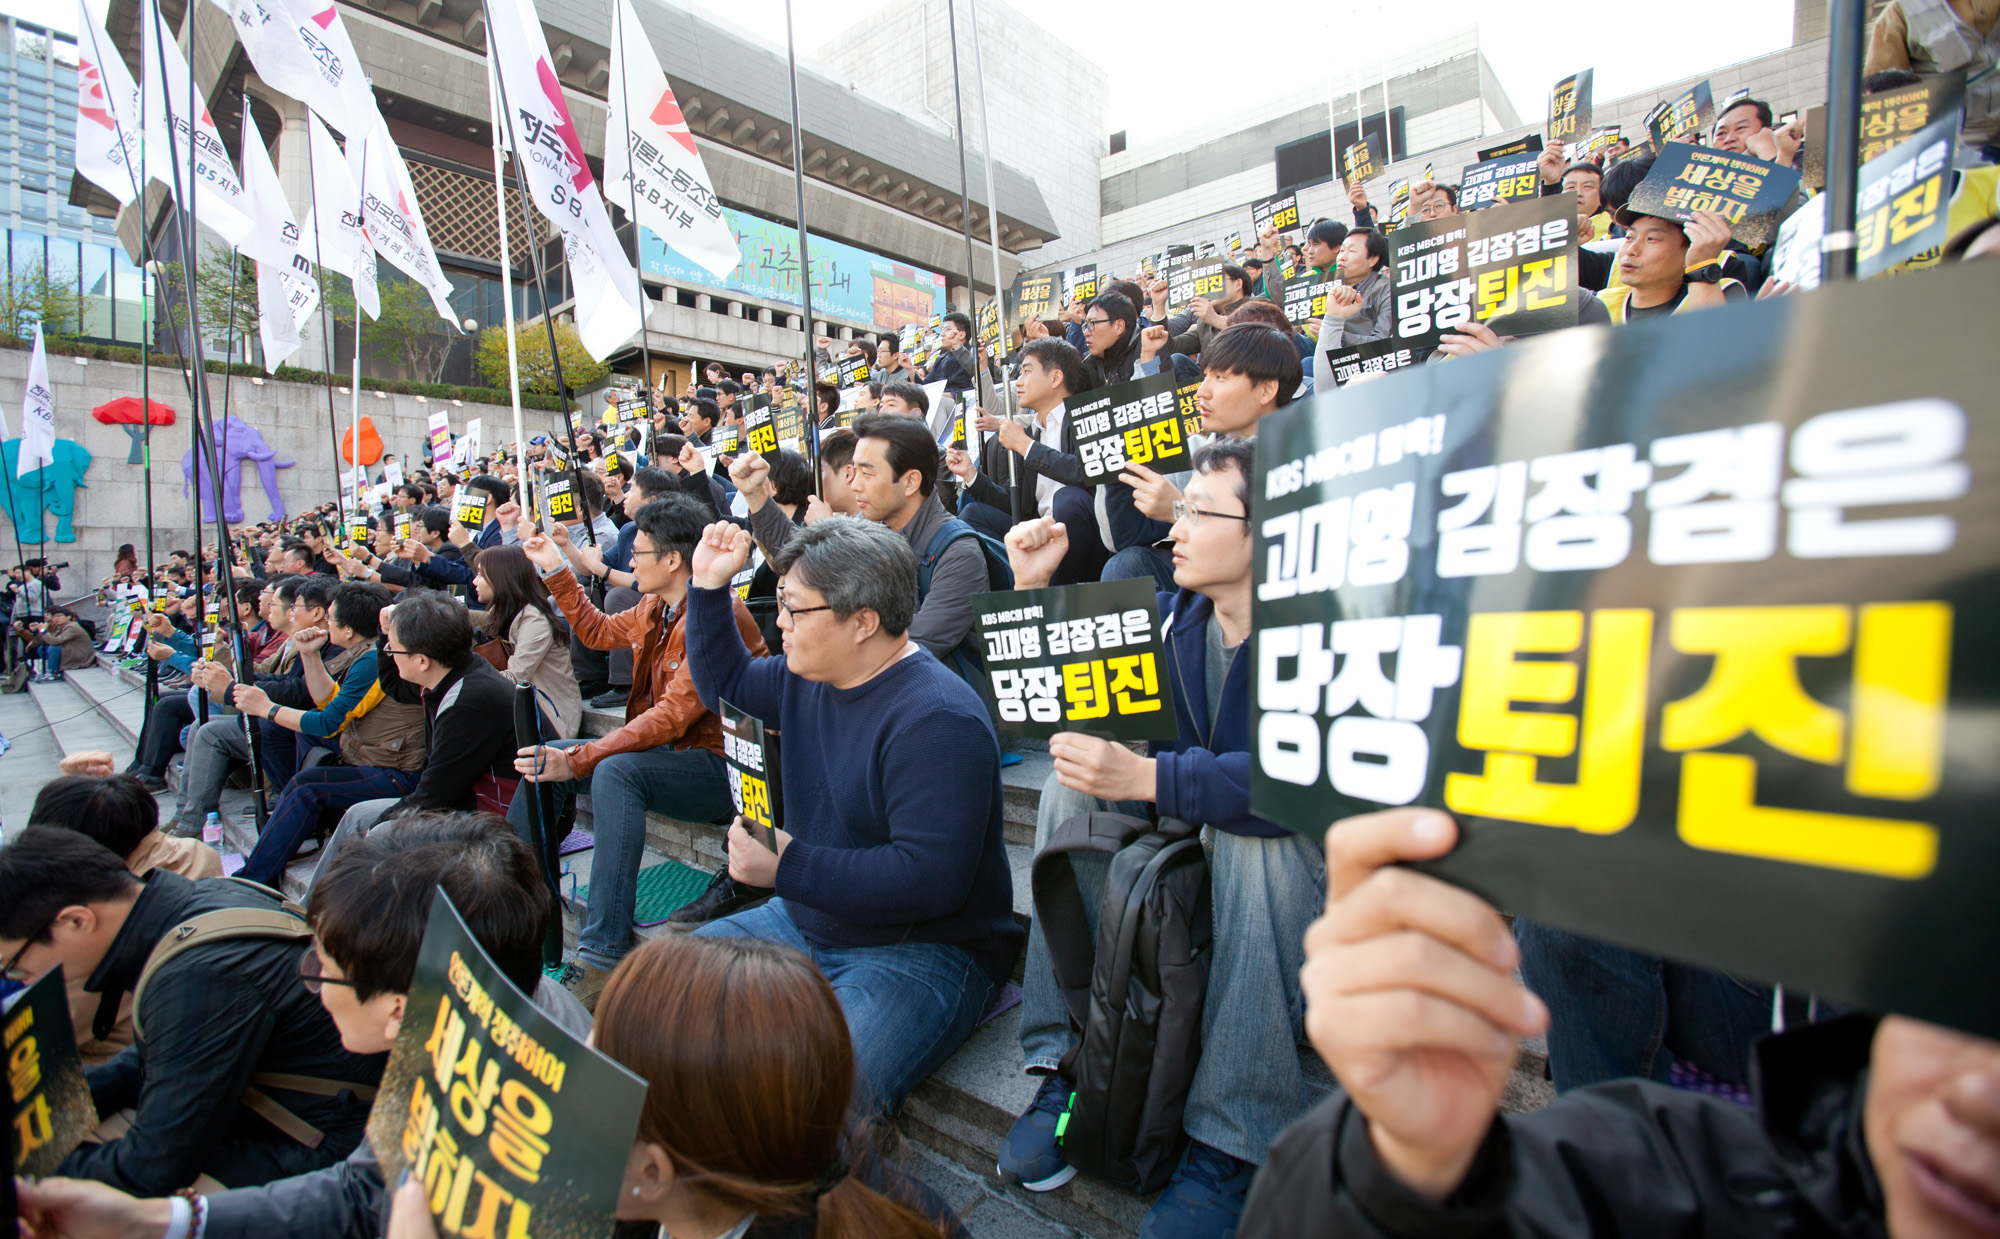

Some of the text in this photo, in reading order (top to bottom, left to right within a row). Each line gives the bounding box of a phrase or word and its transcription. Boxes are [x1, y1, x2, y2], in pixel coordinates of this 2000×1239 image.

[1550, 92, 1577, 118] 상을
[1551, 114, 1576, 139] 히자
[1859, 102, 1930, 140] 상을
[1690, 151, 1731, 167] 언론개혁
[1462, 160, 1539, 189] 고대영 김장겸은
[1674, 162, 1763, 199] 세상을
[551, 184, 591, 228] SB
[1460, 174, 1537, 208] 당장 퇴진
[1663, 185, 1749, 225] 밝히자
[1273, 206, 1298, 229] 퇴진
[1396, 245, 1460, 288] 고대영
[1466, 218, 1569, 269] 김장겸은
[1398, 243, 1416, 257] KBS
[1416, 234, 1445, 252] MBC의
[1190, 262, 1223, 280] 김장겸은
[1019, 284, 1051, 302] 세상을
[1074, 280, 1096, 301] 퇴진
[1168, 274, 1224, 306] 당장 퇴진
[1284, 287, 1308, 303] 고대영
[1397, 255, 1569, 339] 당장 퇴진
[1019, 300, 1049, 319] 밝히자
[1284, 295, 1327, 322] 당장 퇴
[853, 365, 870, 381] 퇴진
[1361, 348, 1413, 374] 김장겸은
[776, 414, 796, 430] 세상을
[1072, 390, 1176, 441] 고대영 김장겸은
[722, 438, 738, 453] 퇴진
[748, 423, 777, 455] 퇴진
[1078, 416, 1184, 478] 당장 퇴진
[551, 492, 574, 516] 퇴진
[1257, 397, 1971, 601] 고대영 김장겸은
[457, 505, 484, 524] 퇴진
[981, 613, 998, 626] KBS
[998, 608, 1024, 624] MBC의
[983, 608, 1152, 662] 고대영 김장겸은
[990, 652, 1162, 722] 당장 퇴진
[1257, 600, 1953, 881] 당장 퇴진
[740, 771, 772, 829] 퇴진
[448, 950, 567, 1094] 언론개혁 쟁취하여
[424, 994, 553, 1184] 세상을
[402, 1075, 533, 1239] 밝히자
